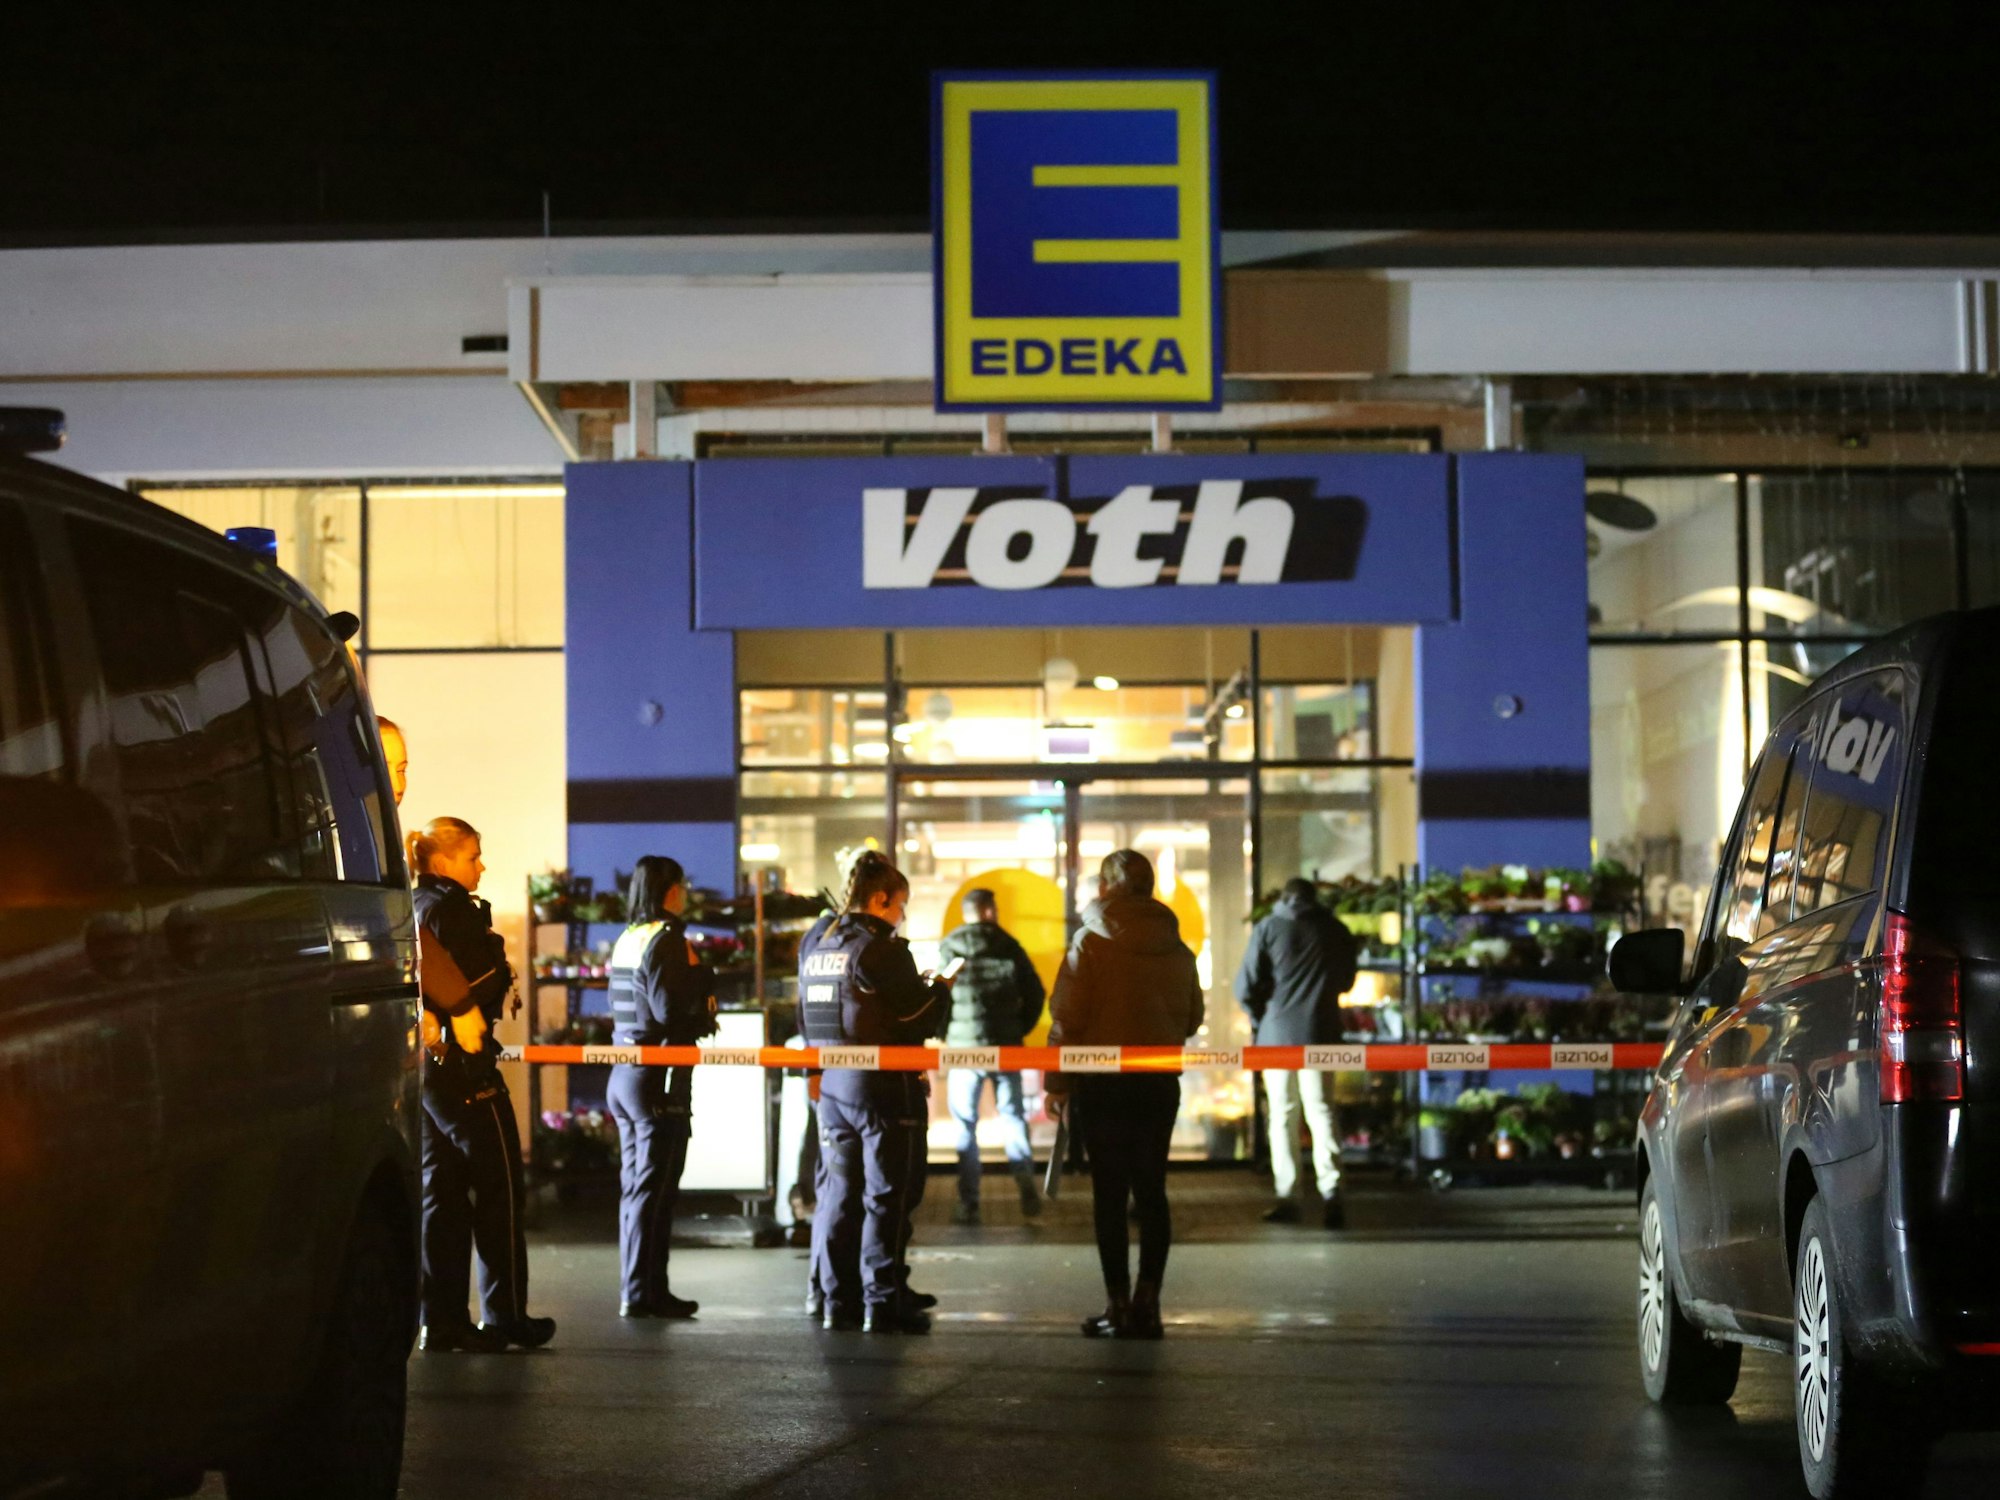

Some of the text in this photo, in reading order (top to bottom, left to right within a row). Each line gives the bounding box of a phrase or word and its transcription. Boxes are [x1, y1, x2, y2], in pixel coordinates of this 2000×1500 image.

[970, 109, 1180, 318] E
[971, 338, 1188, 376] EDEKA
[863, 479, 1294, 590] Voth
[803, 953, 849, 976] POLIZEI
[586, 1053, 637, 1064] POLIZEI
[703, 1055, 756, 1065] POLIZEI
[822, 1054, 875, 1064] POLIZEI
[942, 1053, 996, 1065] POLIZEI
[1063, 1053, 1117, 1065] POLIZEI
[1186, 1052, 1239, 1064] POLIZEI
[1308, 1051, 1362, 1064] POLIZEI
[1431, 1051, 1485, 1064] POLIZEI
[1554, 1051, 1609, 1063] POLIZEI
